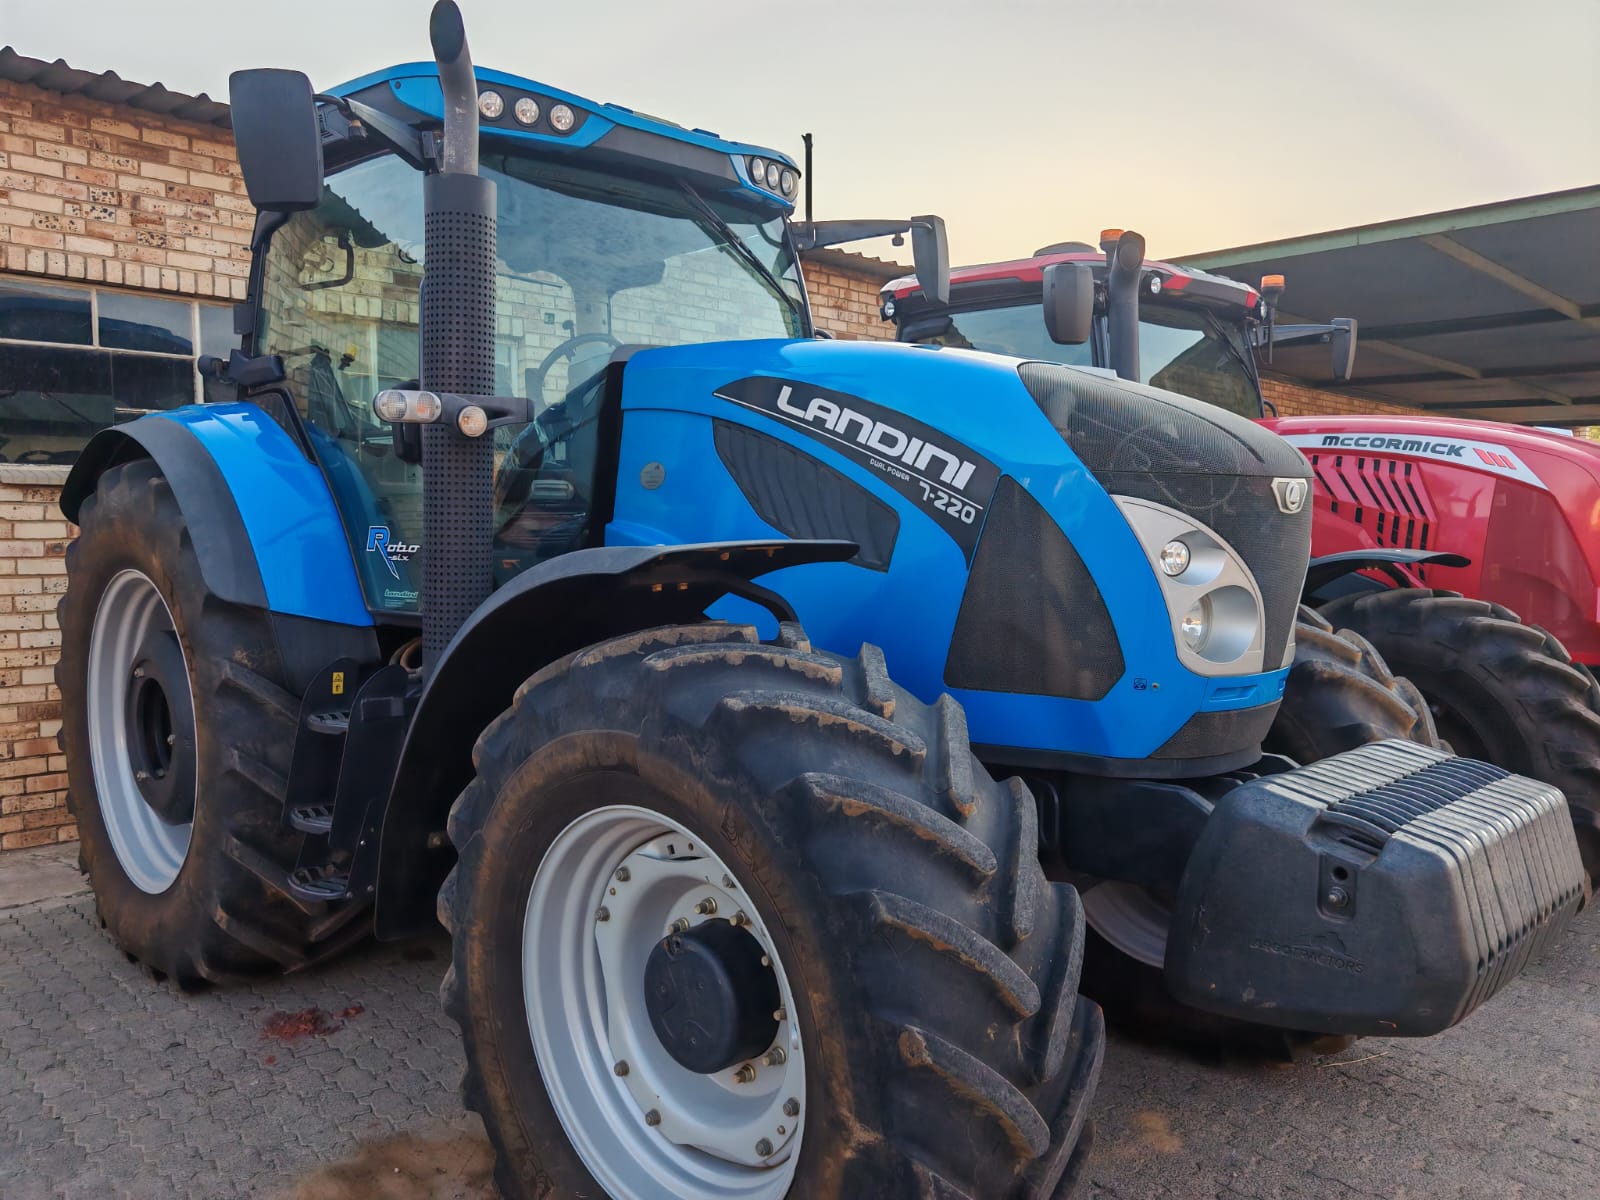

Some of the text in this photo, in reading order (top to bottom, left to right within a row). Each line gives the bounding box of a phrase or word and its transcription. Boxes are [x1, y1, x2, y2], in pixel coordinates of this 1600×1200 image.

[776, 385, 977, 491] LANDINI
[869, 457, 911, 482] DUAL POWER
